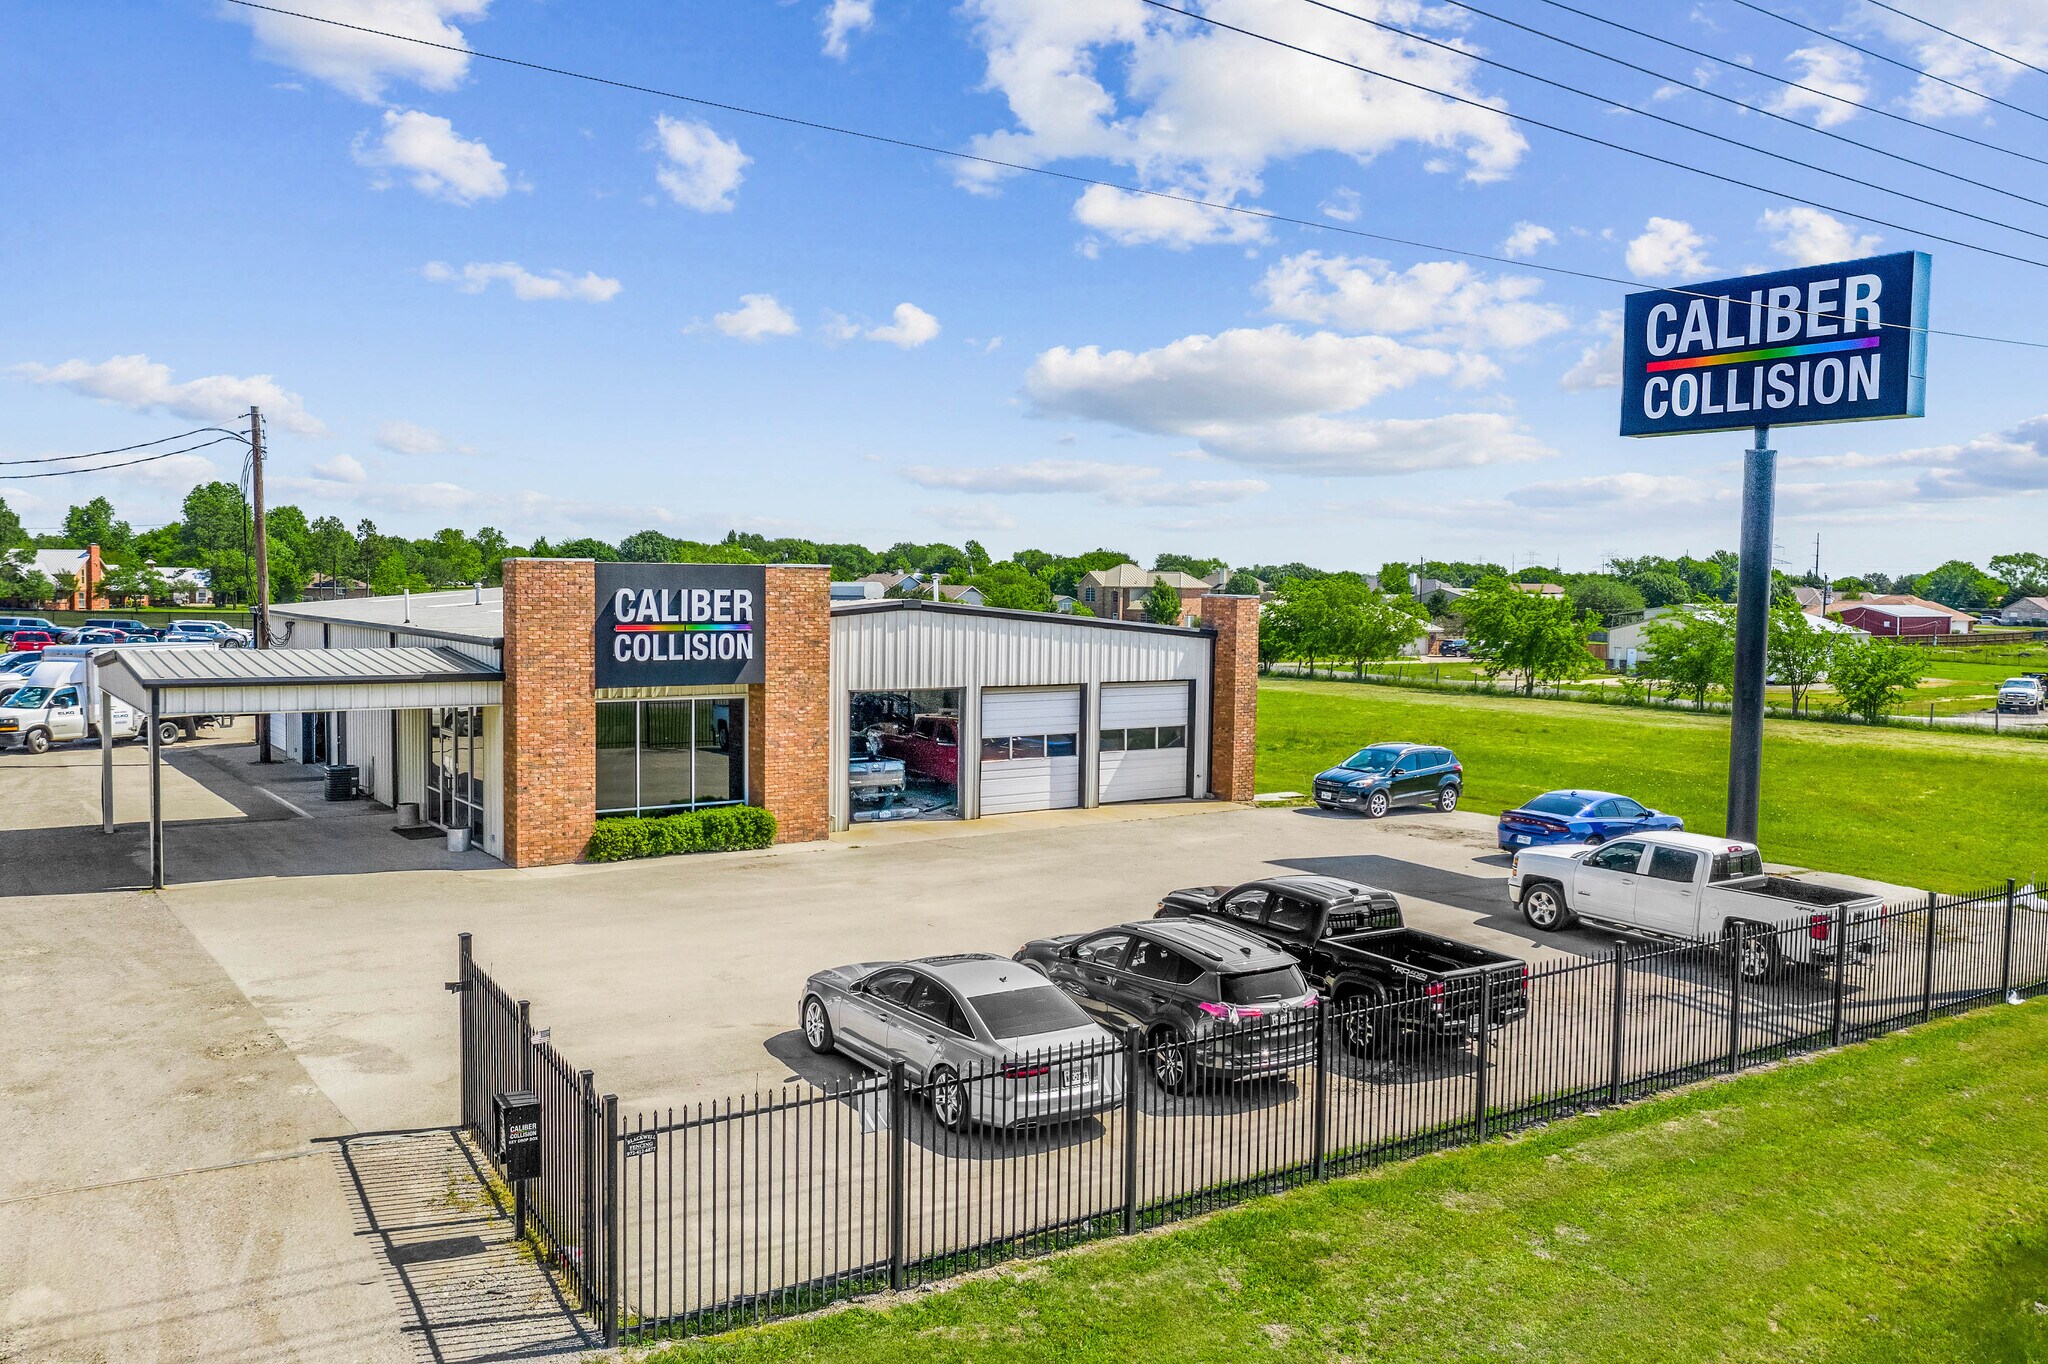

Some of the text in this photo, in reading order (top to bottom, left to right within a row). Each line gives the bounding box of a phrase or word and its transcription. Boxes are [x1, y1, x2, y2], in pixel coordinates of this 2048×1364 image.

[1646, 273, 1883, 357] CALIBER
[1643, 353, 1881, 420] COLLISION
[614, 588, 754, 623] CALIBER
[613, 633, 754, 662] COLLISION
[1391, 964, 1410, 975] TRD
[510, 1123, 537, 1132] CALIBER
[510, 1131, 537, 1139] COLLISION
[626, 1134, 656, 1145] BLACKWELL
[629, 1141, 654, 1151] FENCING
